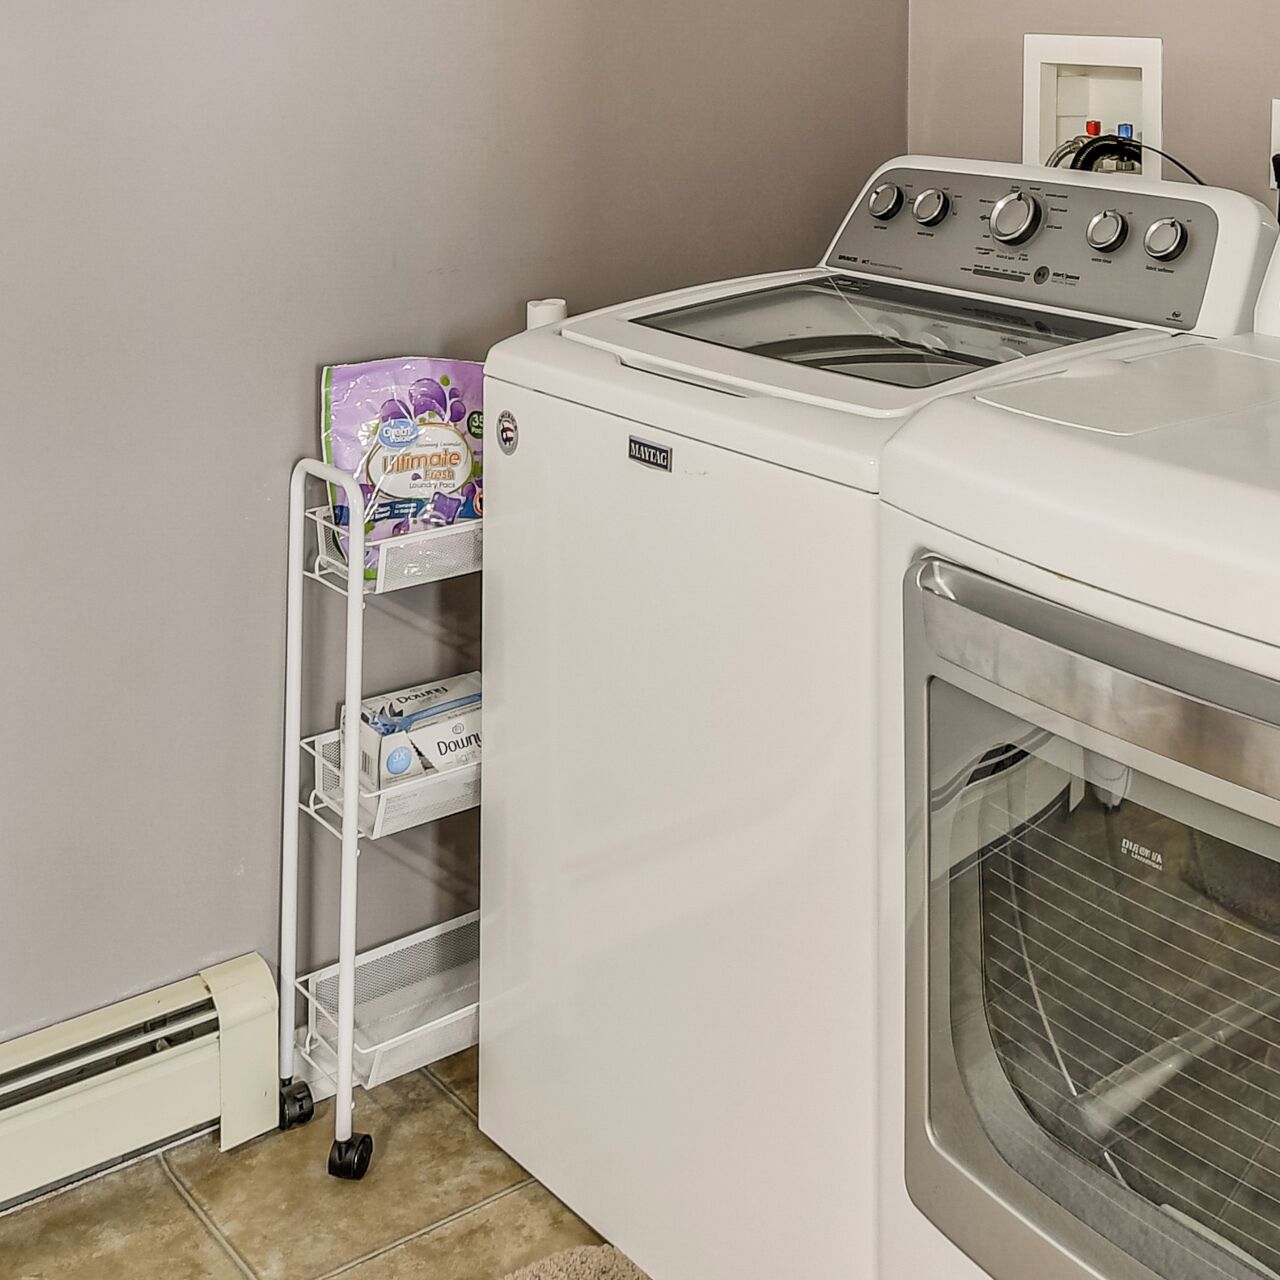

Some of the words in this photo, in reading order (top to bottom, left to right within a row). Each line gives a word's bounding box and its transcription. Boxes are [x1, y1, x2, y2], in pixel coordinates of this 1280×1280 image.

[383, 448, 461, 474] Ultimate
[630, 442, 668, 466] MAYTAG
[423, 468, 455, 481] Fresh
[437, 732, 482, 756] Downy
